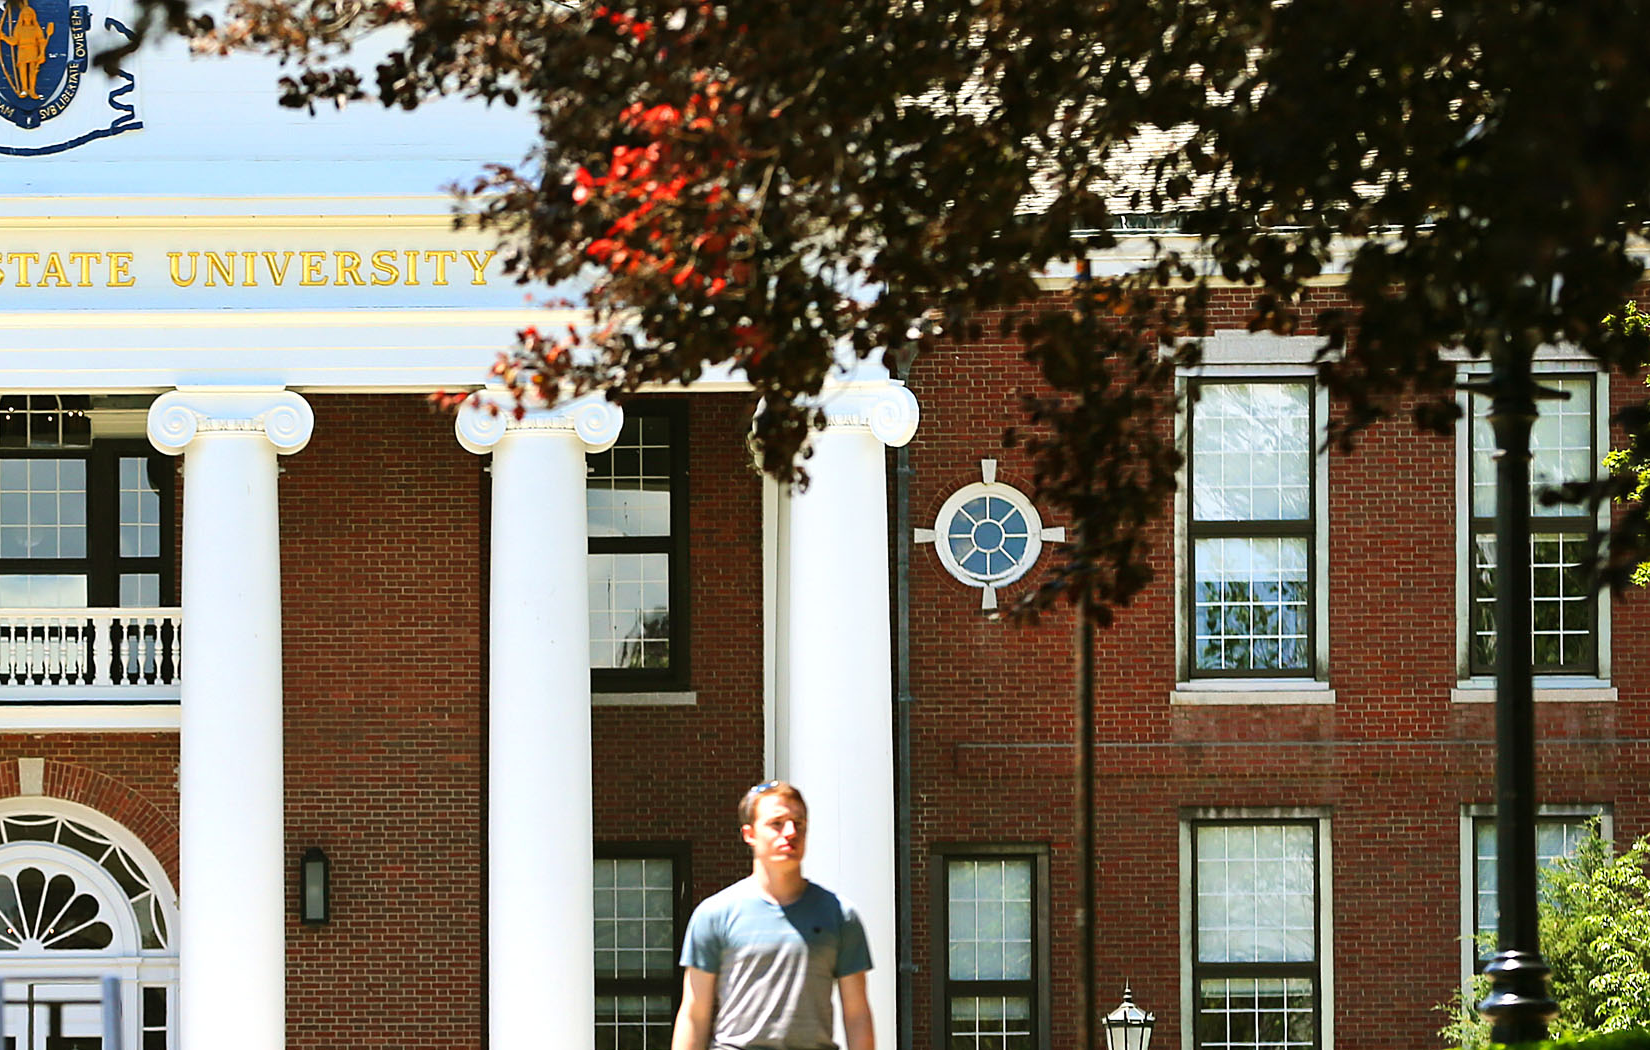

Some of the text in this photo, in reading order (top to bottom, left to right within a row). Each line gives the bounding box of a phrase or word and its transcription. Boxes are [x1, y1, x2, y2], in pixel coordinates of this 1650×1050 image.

[39, 105, 57, 119] SVB
[55, 63, 79, 110] LIBERTATE
[167, 250, 497, 286] UNIVERSITY
